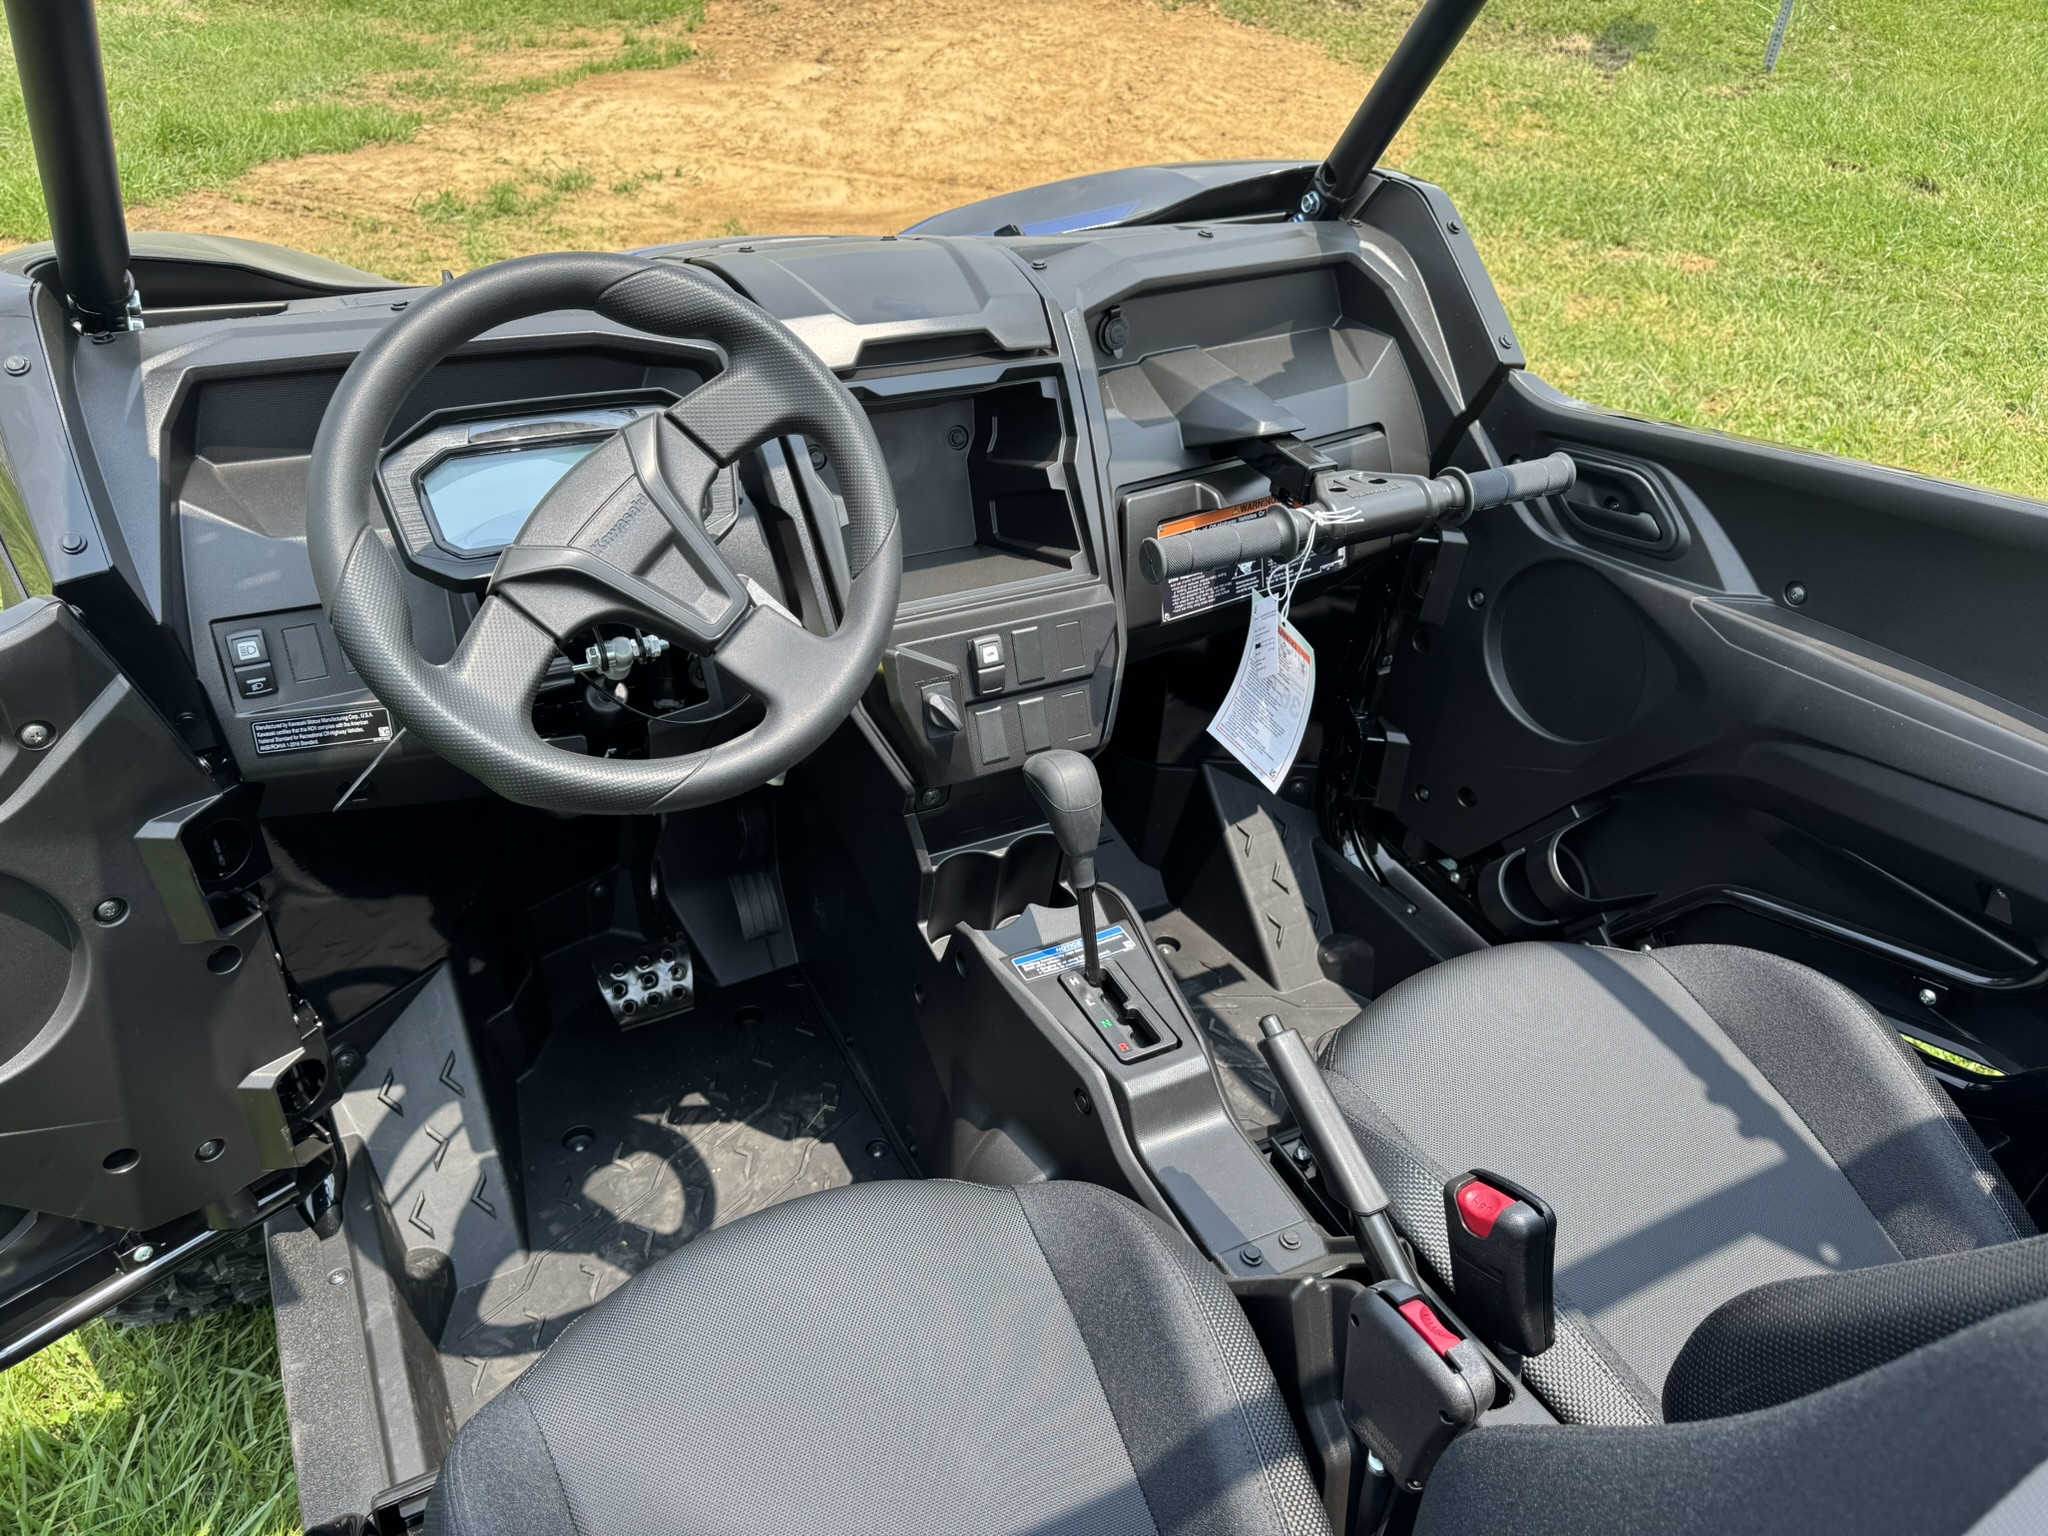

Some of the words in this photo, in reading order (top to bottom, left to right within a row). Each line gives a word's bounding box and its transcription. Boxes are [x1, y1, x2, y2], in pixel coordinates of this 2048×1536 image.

[590, 492, 651, 553] Kawasaki
[1069, 976, 1080, 986] H
[1101, 1018, 1113, 1029] N
[1118, 1042, 1130, 1052] R
